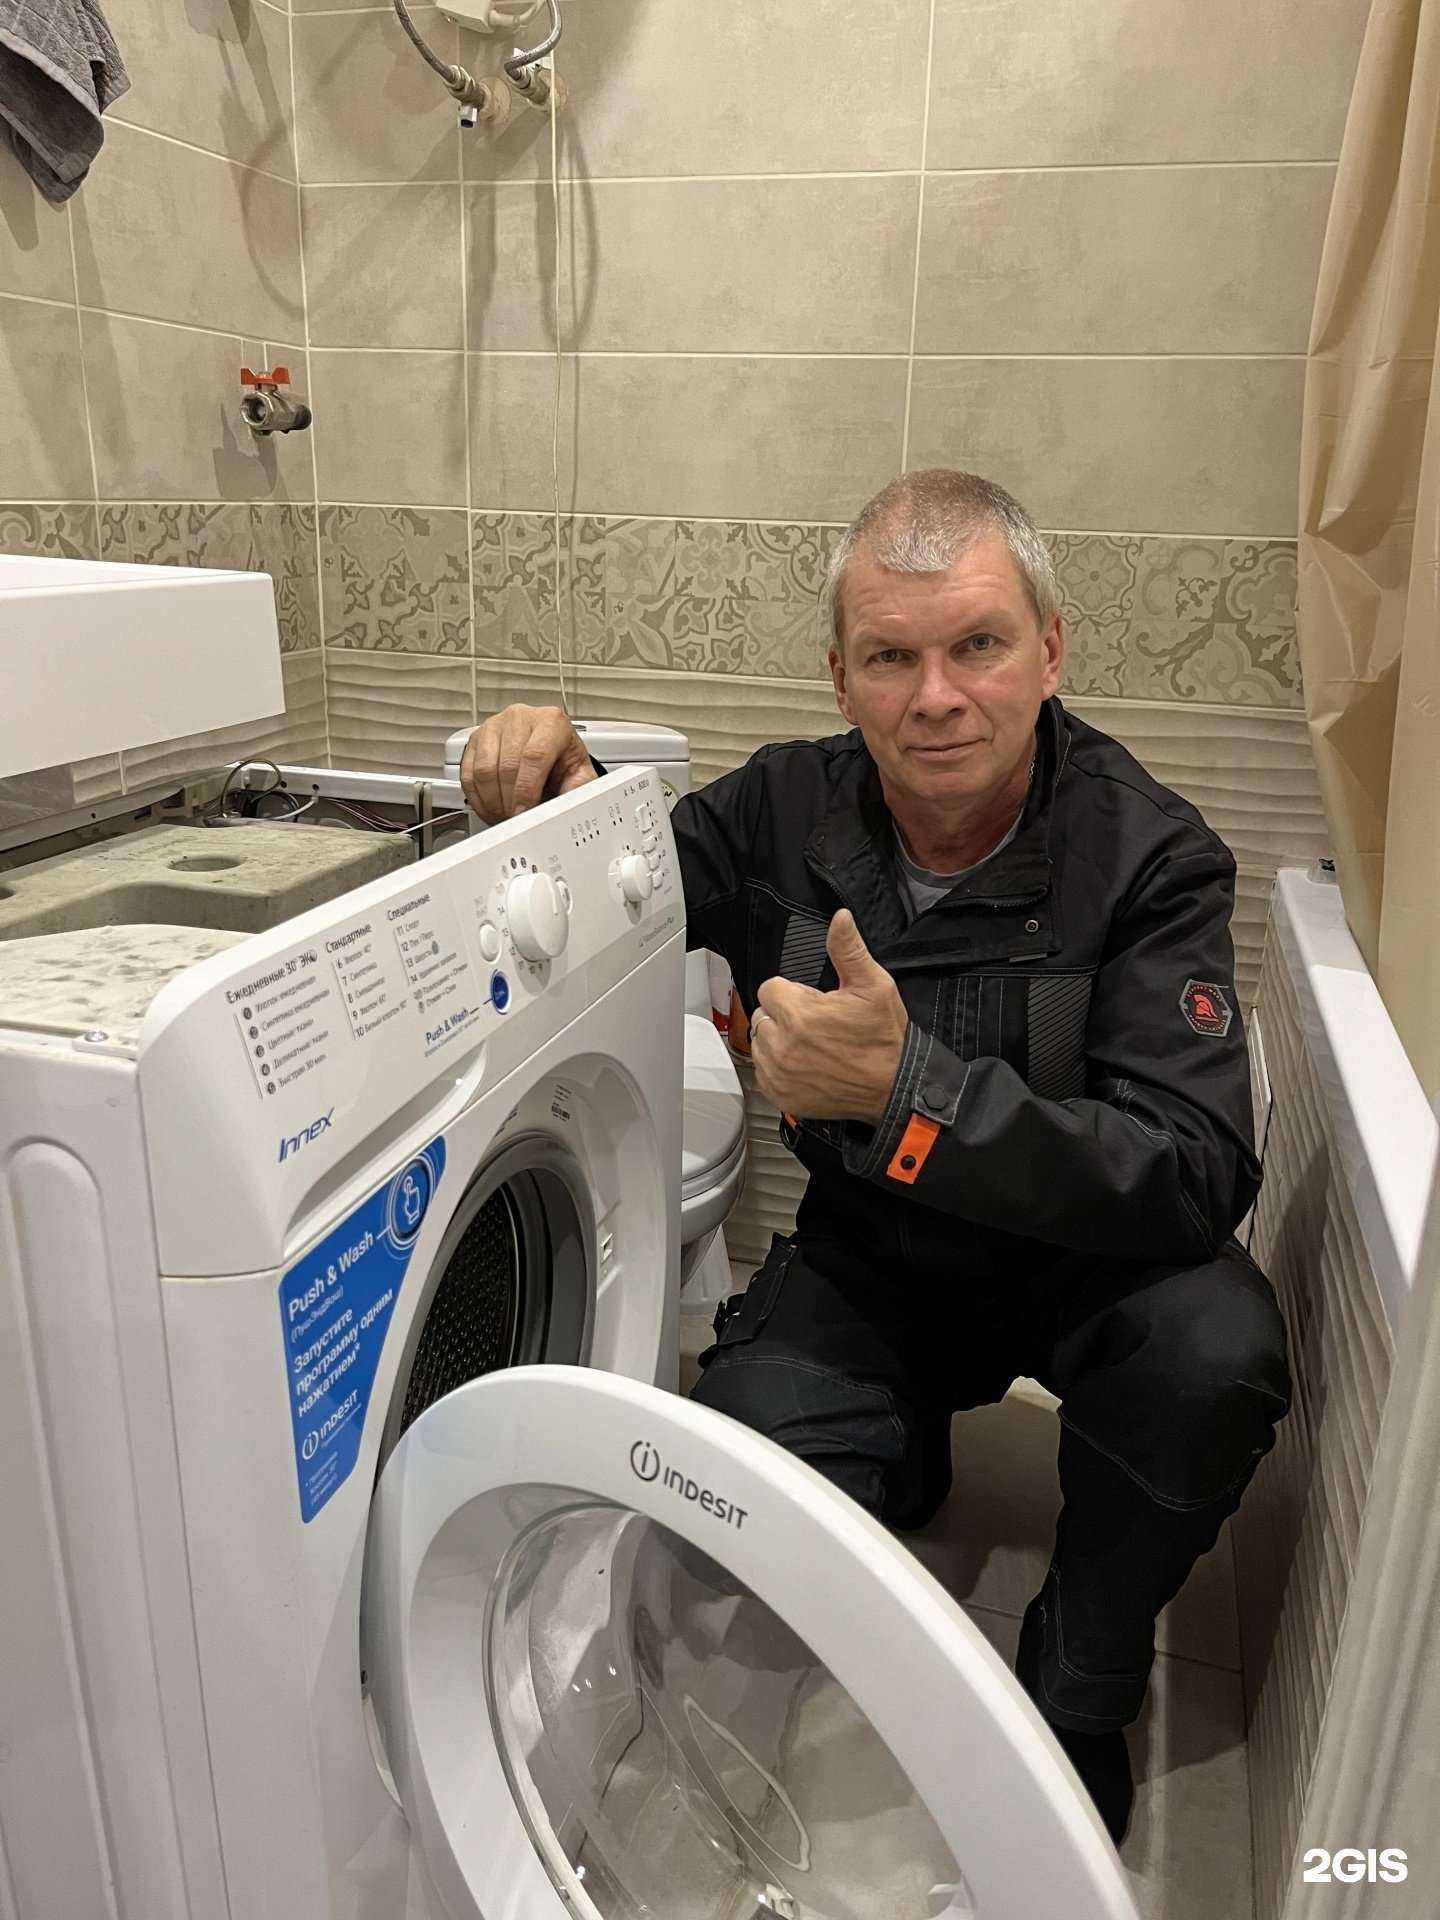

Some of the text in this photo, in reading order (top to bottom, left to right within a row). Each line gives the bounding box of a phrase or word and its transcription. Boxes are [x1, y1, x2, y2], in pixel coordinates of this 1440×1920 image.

[325, 923, 371, 954] Стандартные
[226, 968, 286, 1004] Ежедневные
[425, 1025, 445, 1046] Push
[450, 1007, 470, 1027] Wash
[278, 1106, 335, 1163] Innex
[289, 1230, 374, 1323] Push & Wash
[294, 1308, 353, 1374] Запустите
[296, 1322, 359, 1397] программу
[360, 1288, 393, 1330] одним
